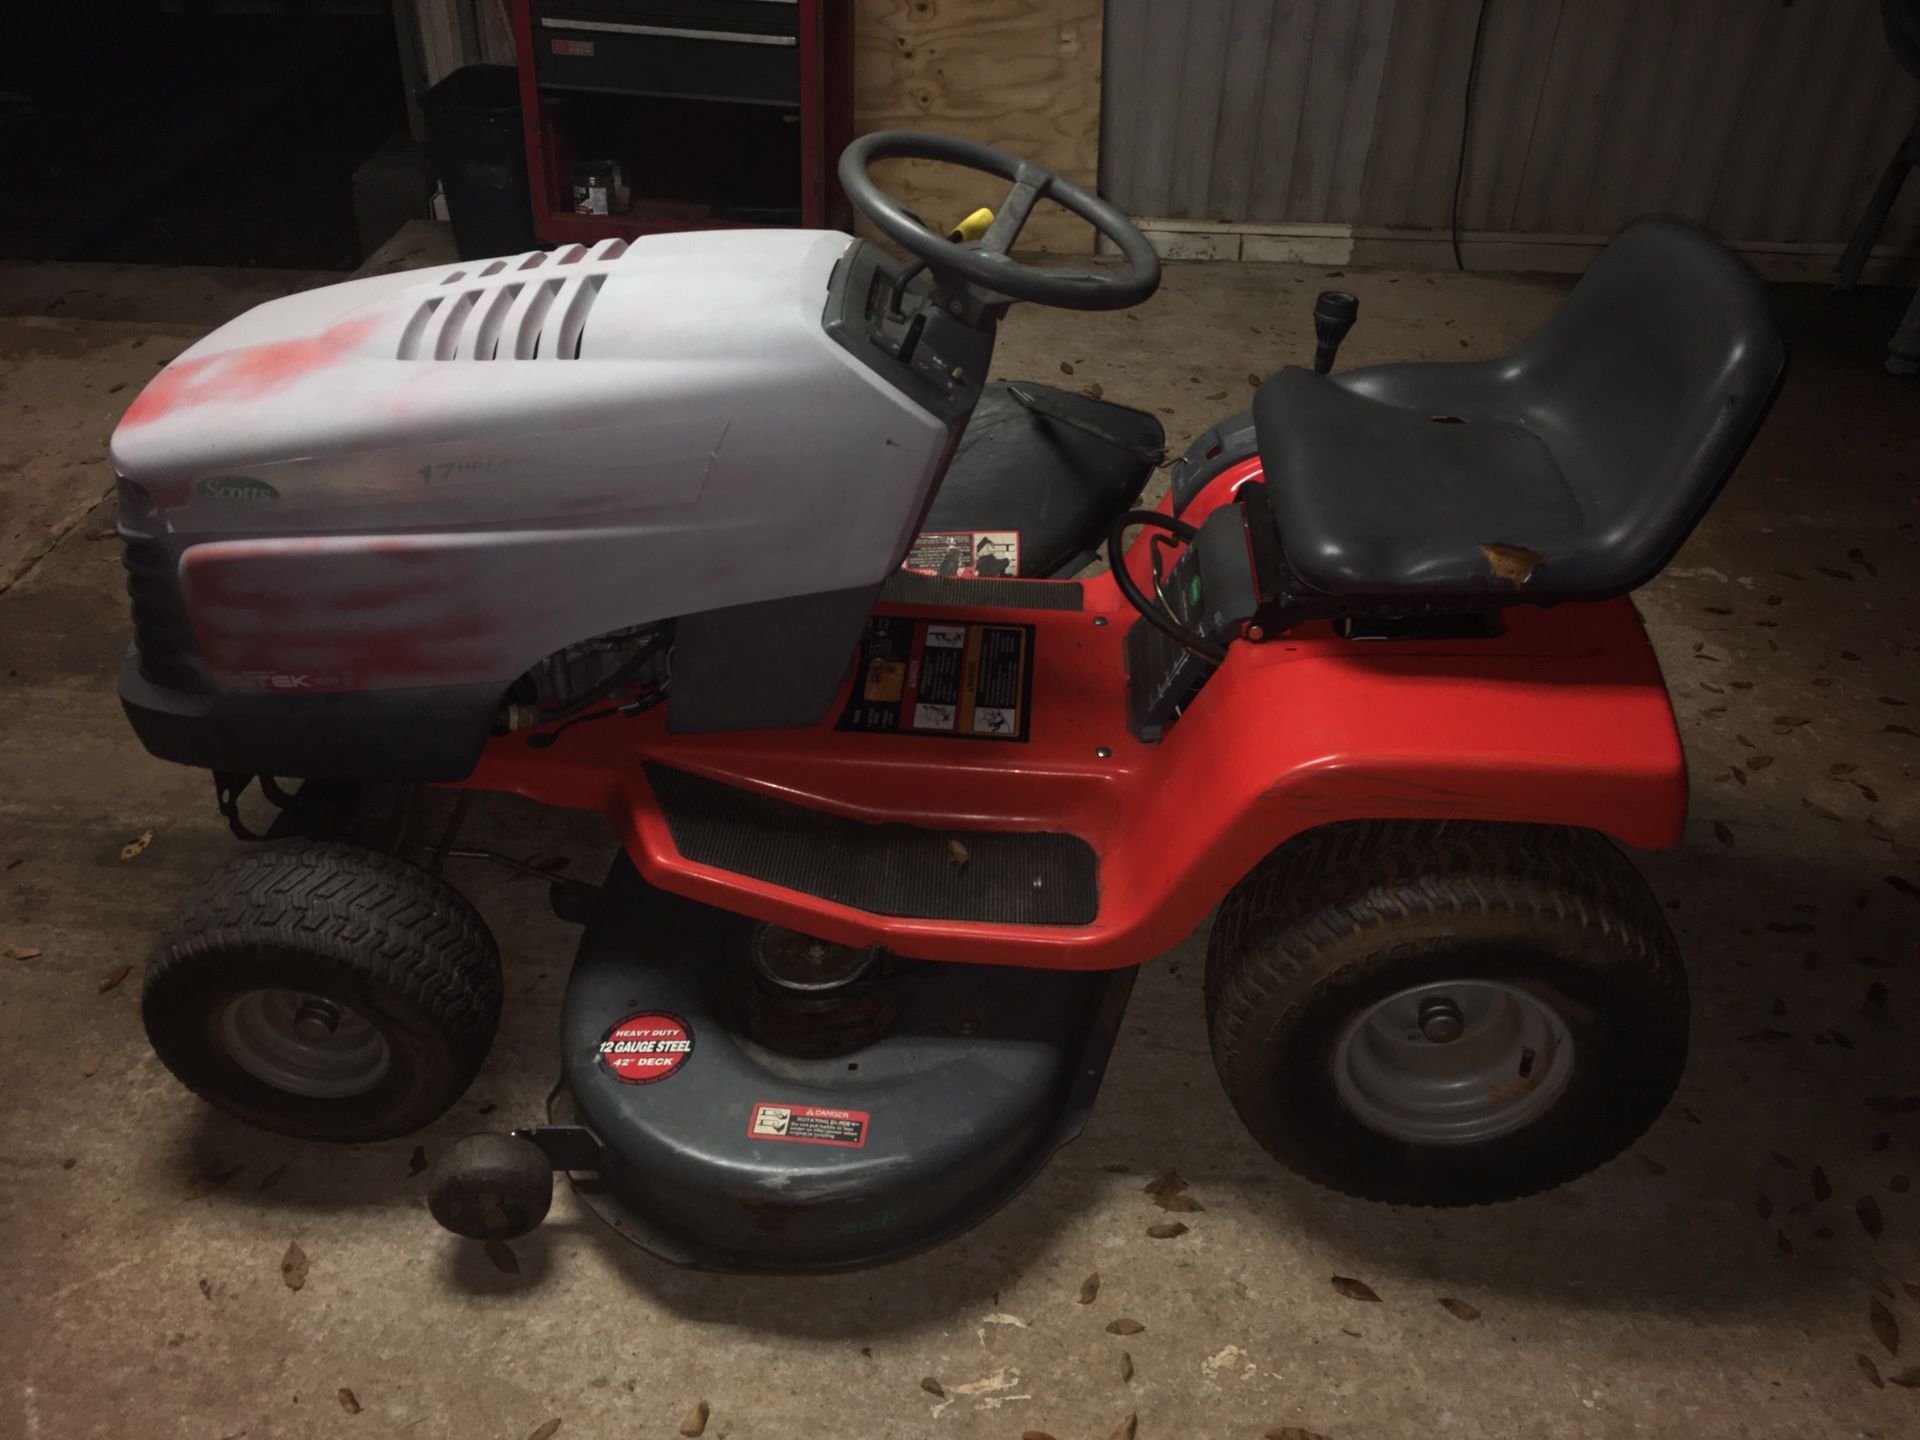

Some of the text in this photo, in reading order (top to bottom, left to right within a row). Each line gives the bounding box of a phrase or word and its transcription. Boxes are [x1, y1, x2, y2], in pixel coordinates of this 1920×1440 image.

[615, 1029, 680, 1037] HEAVY DUTY
[599, 1040, 691, 1053] 12 GAUGE STEEL
[637, 1057, 673, 1066] DECK
[815, 1109, 849, 1119] DANGER
